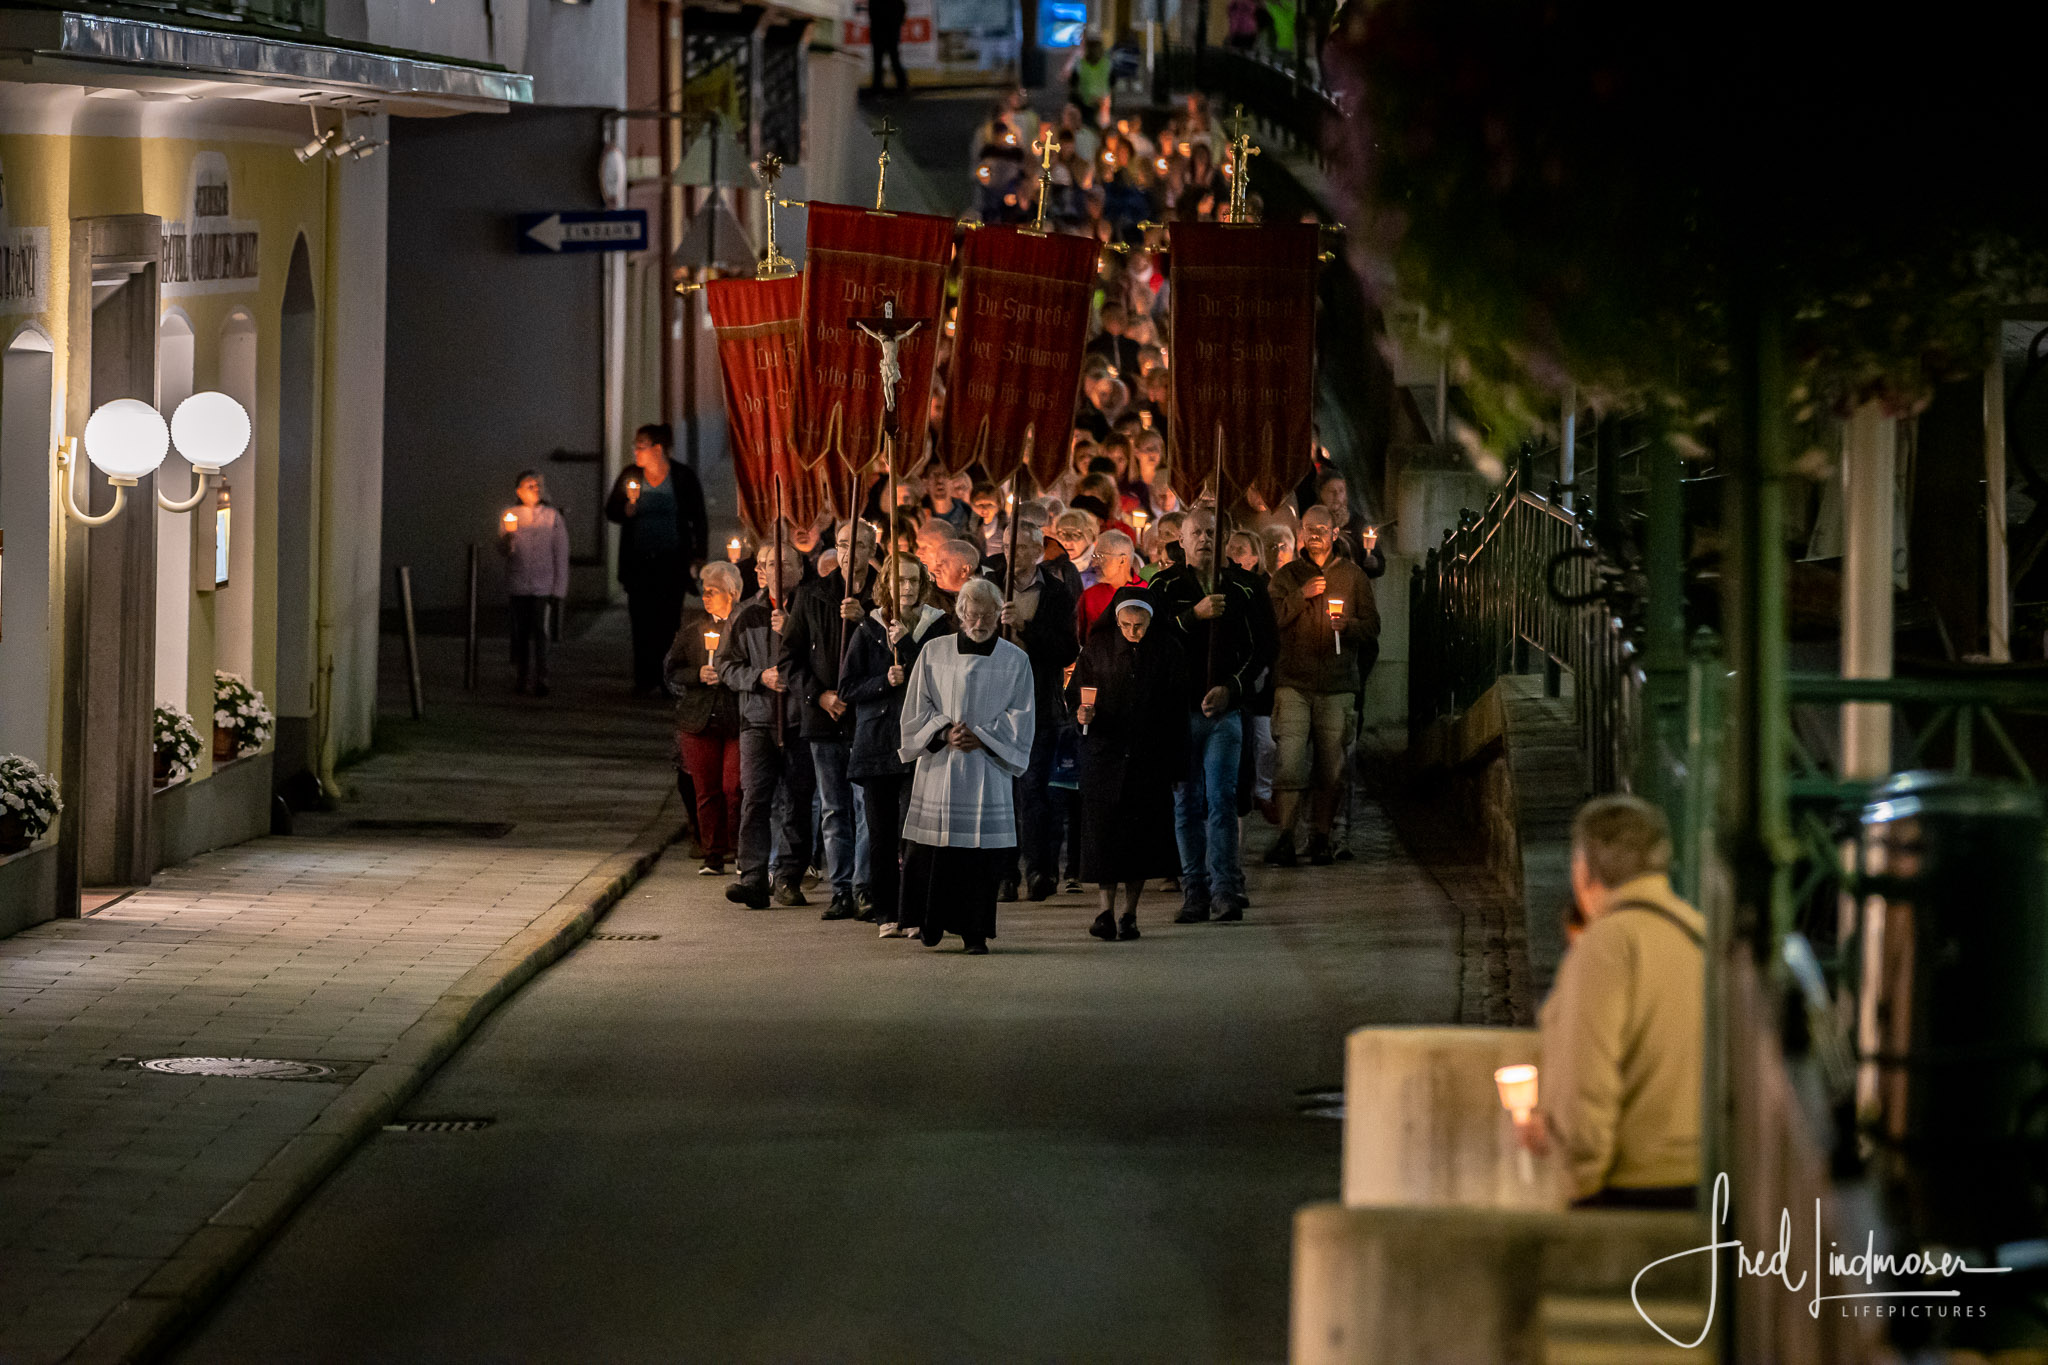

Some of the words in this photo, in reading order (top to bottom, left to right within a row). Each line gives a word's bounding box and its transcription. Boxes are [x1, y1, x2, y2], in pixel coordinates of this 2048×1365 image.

[843, 279, 867, 303] Du
[975, 291, 998, 318] Du
[817, 319, 843, 345] der
[756, 347, 779, 369] Du
[969, 337, 994, 361] der
